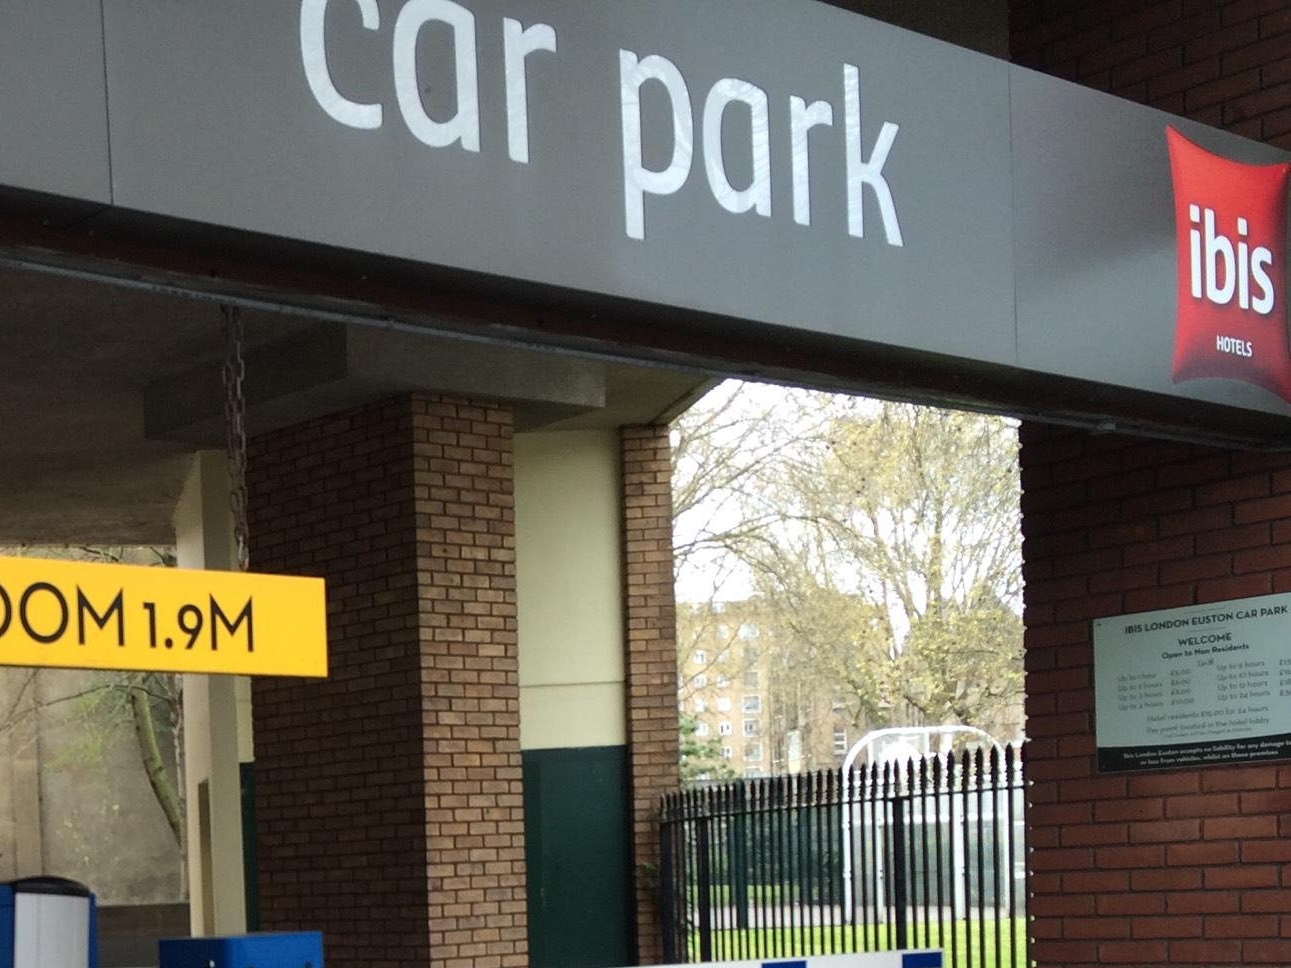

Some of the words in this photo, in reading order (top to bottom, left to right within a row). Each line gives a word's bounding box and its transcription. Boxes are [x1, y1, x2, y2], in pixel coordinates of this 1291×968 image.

[300, 0, 556, 164] car
[620, 48, 903, 246] park
[1189, 204, 1275, 315] ibis
[1216, 334, 1253, 357] HOTELS
[144, 593, 254, 653] 1.9M
[1125, 624, 1142, 634] IBIS
[1144, 618, 1189, 632] LONDON
[1191, 612, 1234, 626] EUSTON
[1236, 609, 1257, 620] CAR
[1260, 605, 1288, 617] PARK
[1161, 650, 1183, 660] Open
[1194, 647, 1210, 655] Non
[1211, 642, 1249, 653] Residents
[1177, 632, 1232, 646] WELCOME
